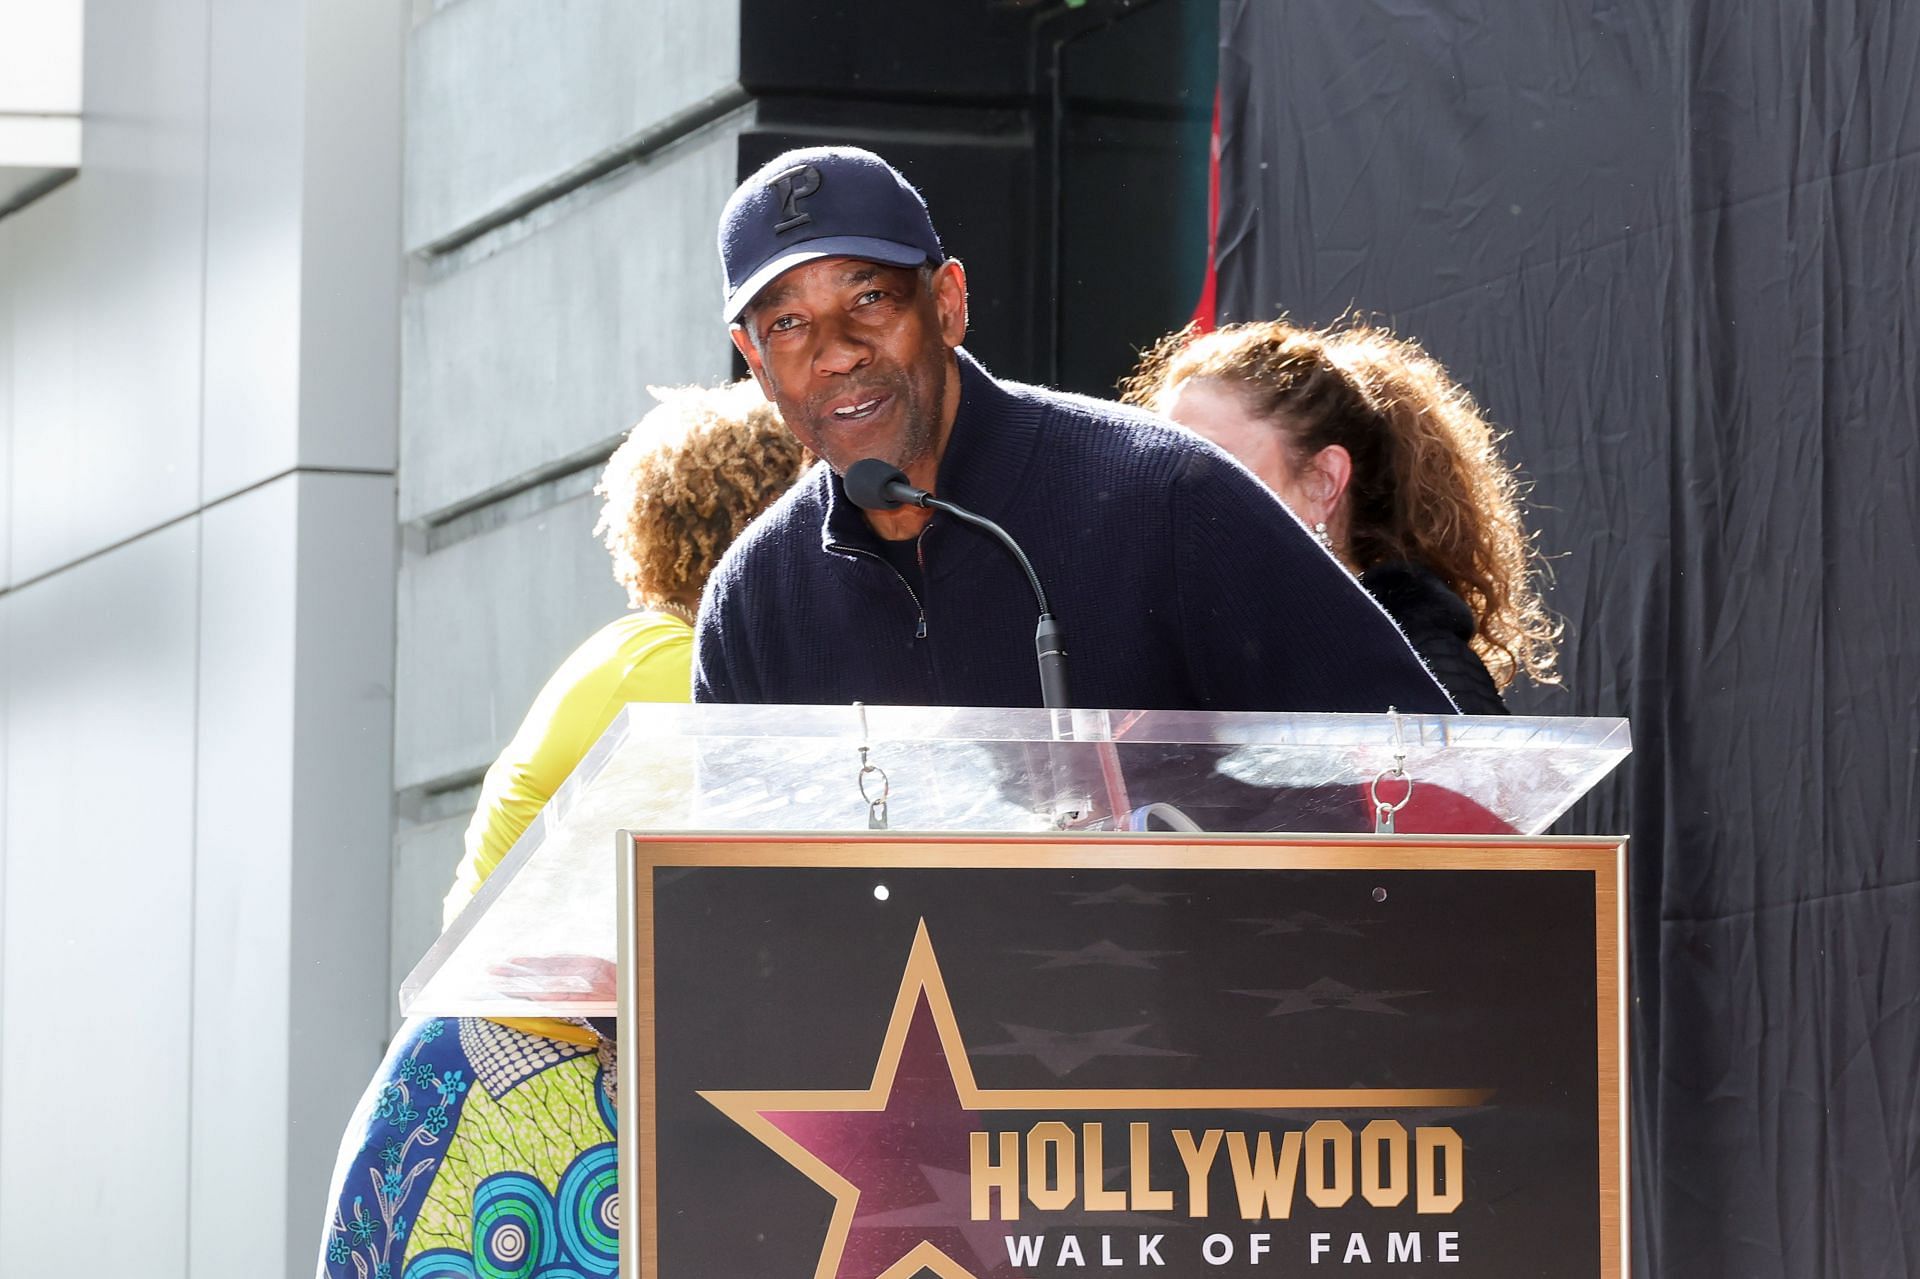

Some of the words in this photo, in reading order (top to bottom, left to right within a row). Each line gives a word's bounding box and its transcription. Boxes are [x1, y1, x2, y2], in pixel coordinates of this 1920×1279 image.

[767, 164, 821, 235] P
[969, 1119, 1464, 1221] HOLLYWOOD
[1004, 1234, 1166, 1267] WALK
[1201, 1233, 1271, 1266] OF
[1309, 1231, 1461, 1264] FAME
